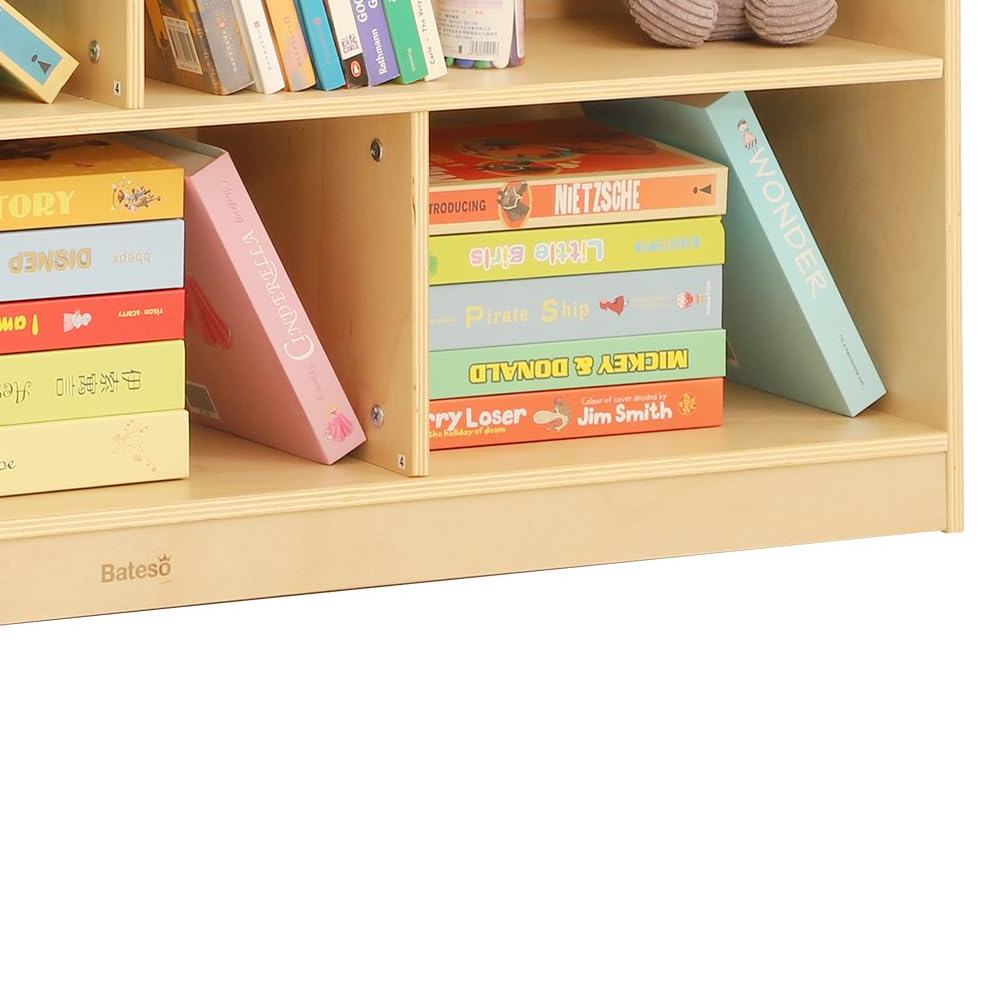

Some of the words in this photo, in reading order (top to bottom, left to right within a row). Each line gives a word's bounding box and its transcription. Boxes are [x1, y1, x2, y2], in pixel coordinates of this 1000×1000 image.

[415, 0, 425, 16] Very
[420, 18, 428, 32] The
[370, 28, 387, 75] Rathmann
[426, 46, 435, 64] Carle
[554, 180, 641, 216] NIETZSCHE
[747, 146, 828, 298] WONDER
[534, 238, 605, 265] Little
[31, 313, 40, 335] I
[465, 304, 529, 328] Pirate
[541, 298, 591, 324] Ship
[469, 356, 570, 384] DONALD
[574, 354, 594, 376] &
[597, 347, 690, 376] MICKEY
[55, 369, 142, 397] 伊索寓言
[466, 407, 528, 428] Loser
[577, 406, 612, 427] Jim
[615, 401, 673, 423] Smith
[443, 428, 474, 439] holiday
[485, 426, 506, 435] doom
[101, 560, 172, 583] Bateso
